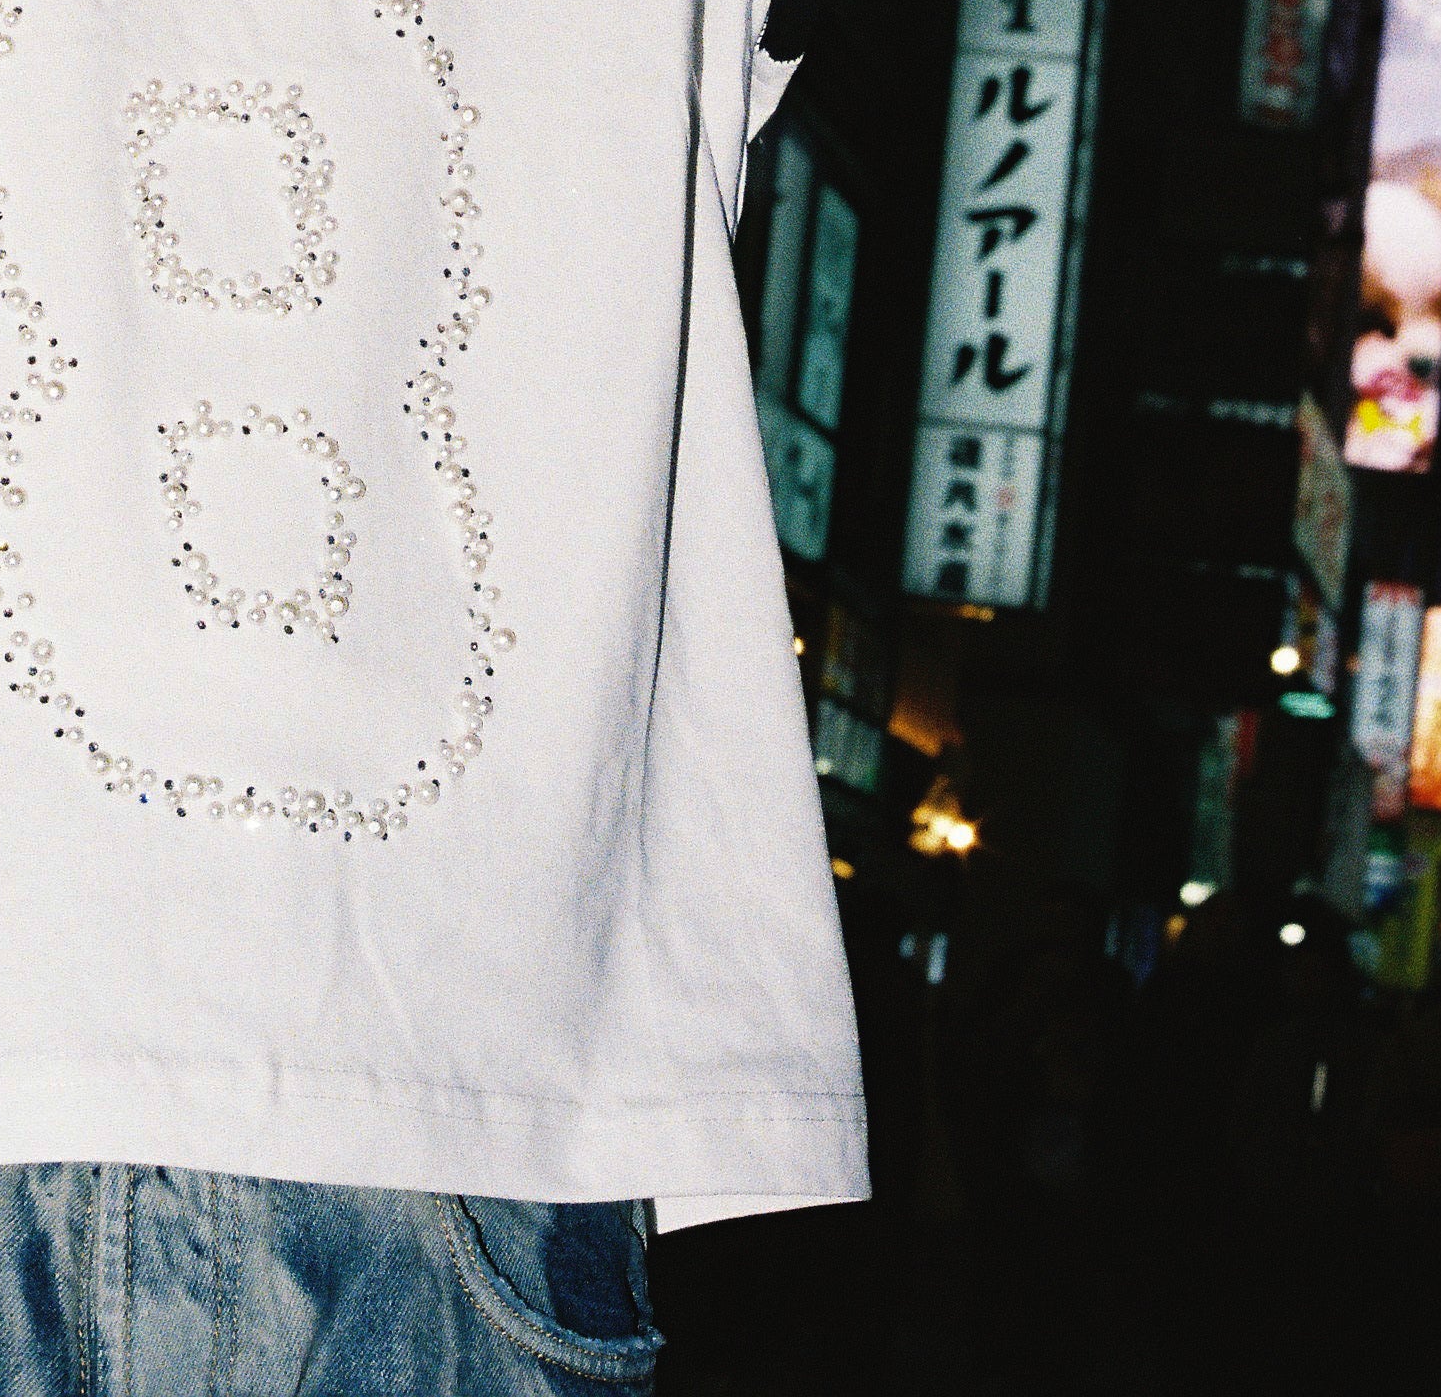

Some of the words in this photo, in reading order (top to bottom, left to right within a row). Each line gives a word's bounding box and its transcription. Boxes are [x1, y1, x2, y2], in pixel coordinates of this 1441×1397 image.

[951, 61, 1052, 393] ルノアール
